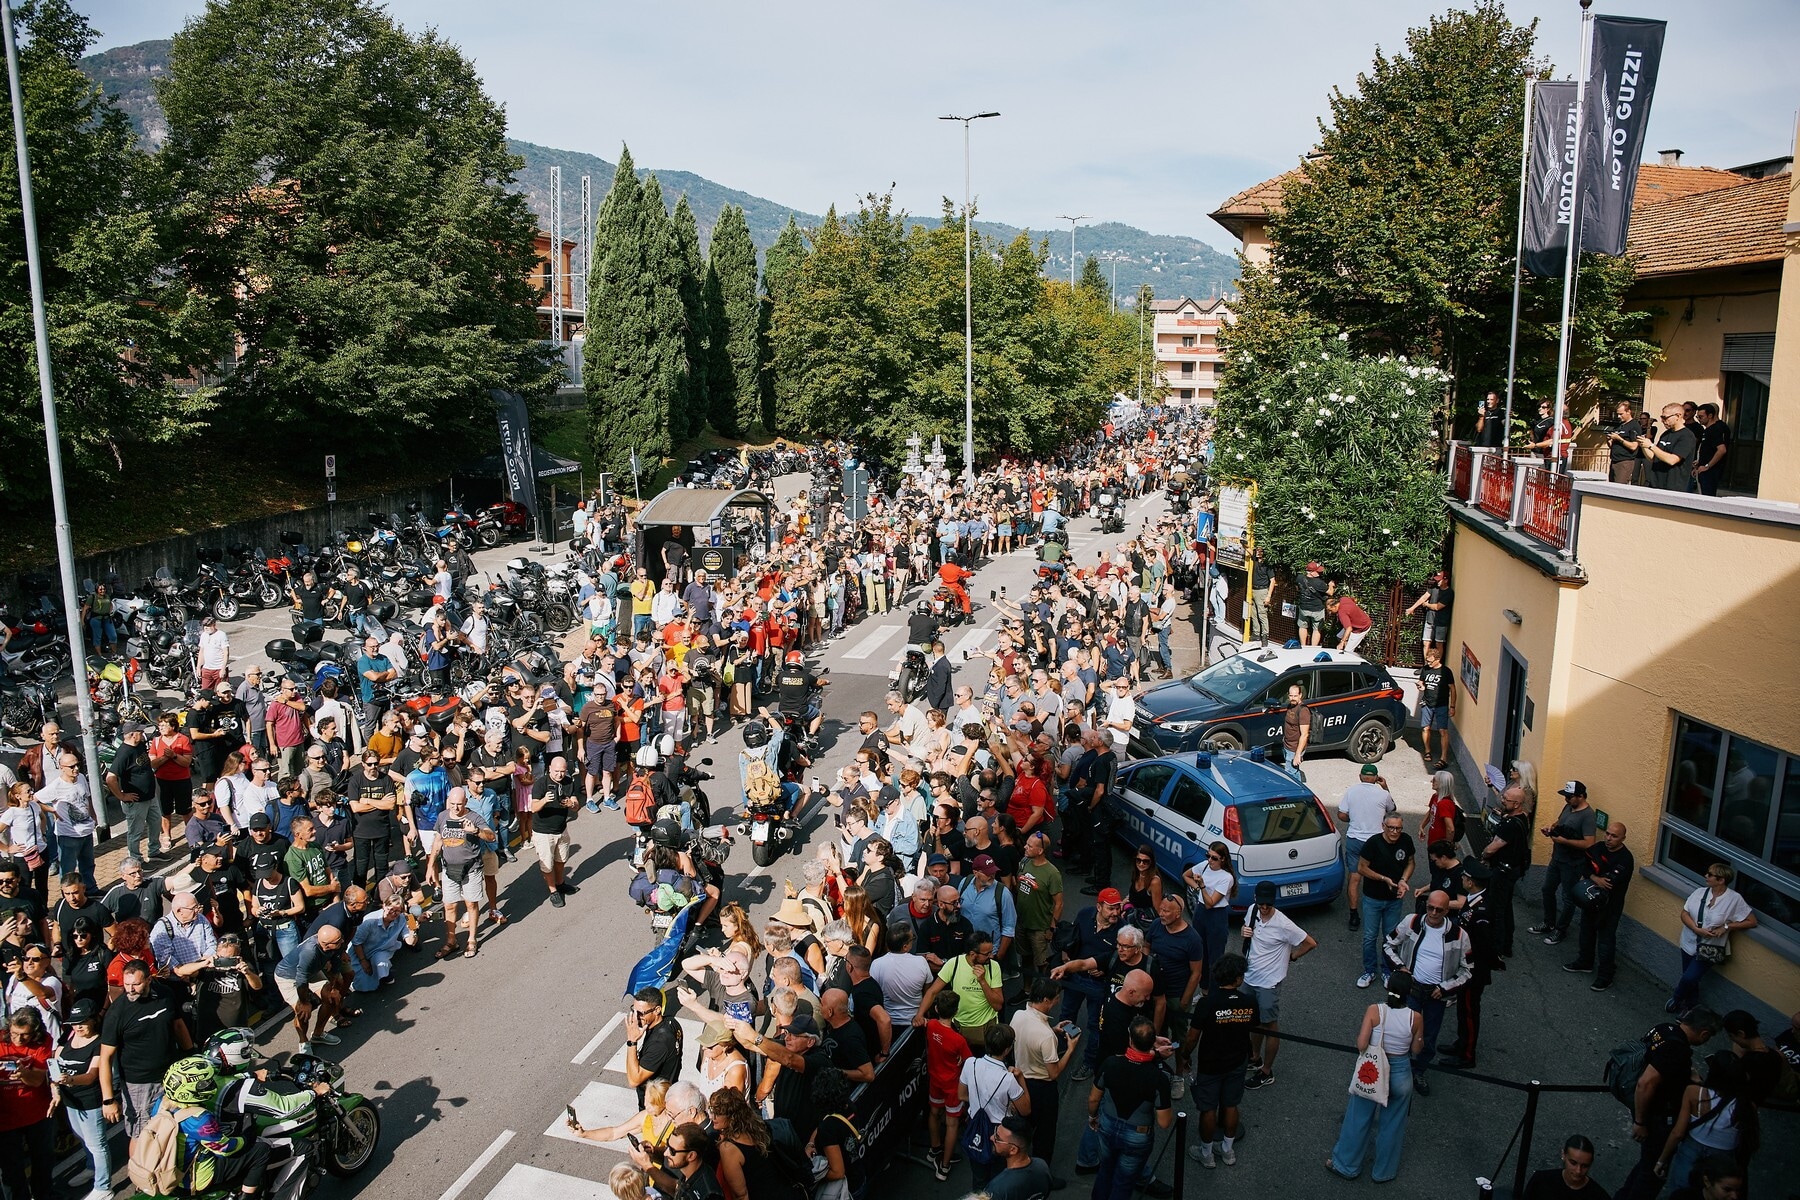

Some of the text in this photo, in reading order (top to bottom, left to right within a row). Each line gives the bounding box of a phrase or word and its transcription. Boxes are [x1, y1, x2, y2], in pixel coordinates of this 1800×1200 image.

[1611, 51, 1642, 190] MOTO GUZZI
[1557, 171, 1573, 224] MOTO
[538, 467, 567, 477] REGISTRATION
[1262, 803, 1296, 812] POLIZIA
[1207, 824, 1223, 836] 113
[867, 1107, 892, 1147] GUZZI
